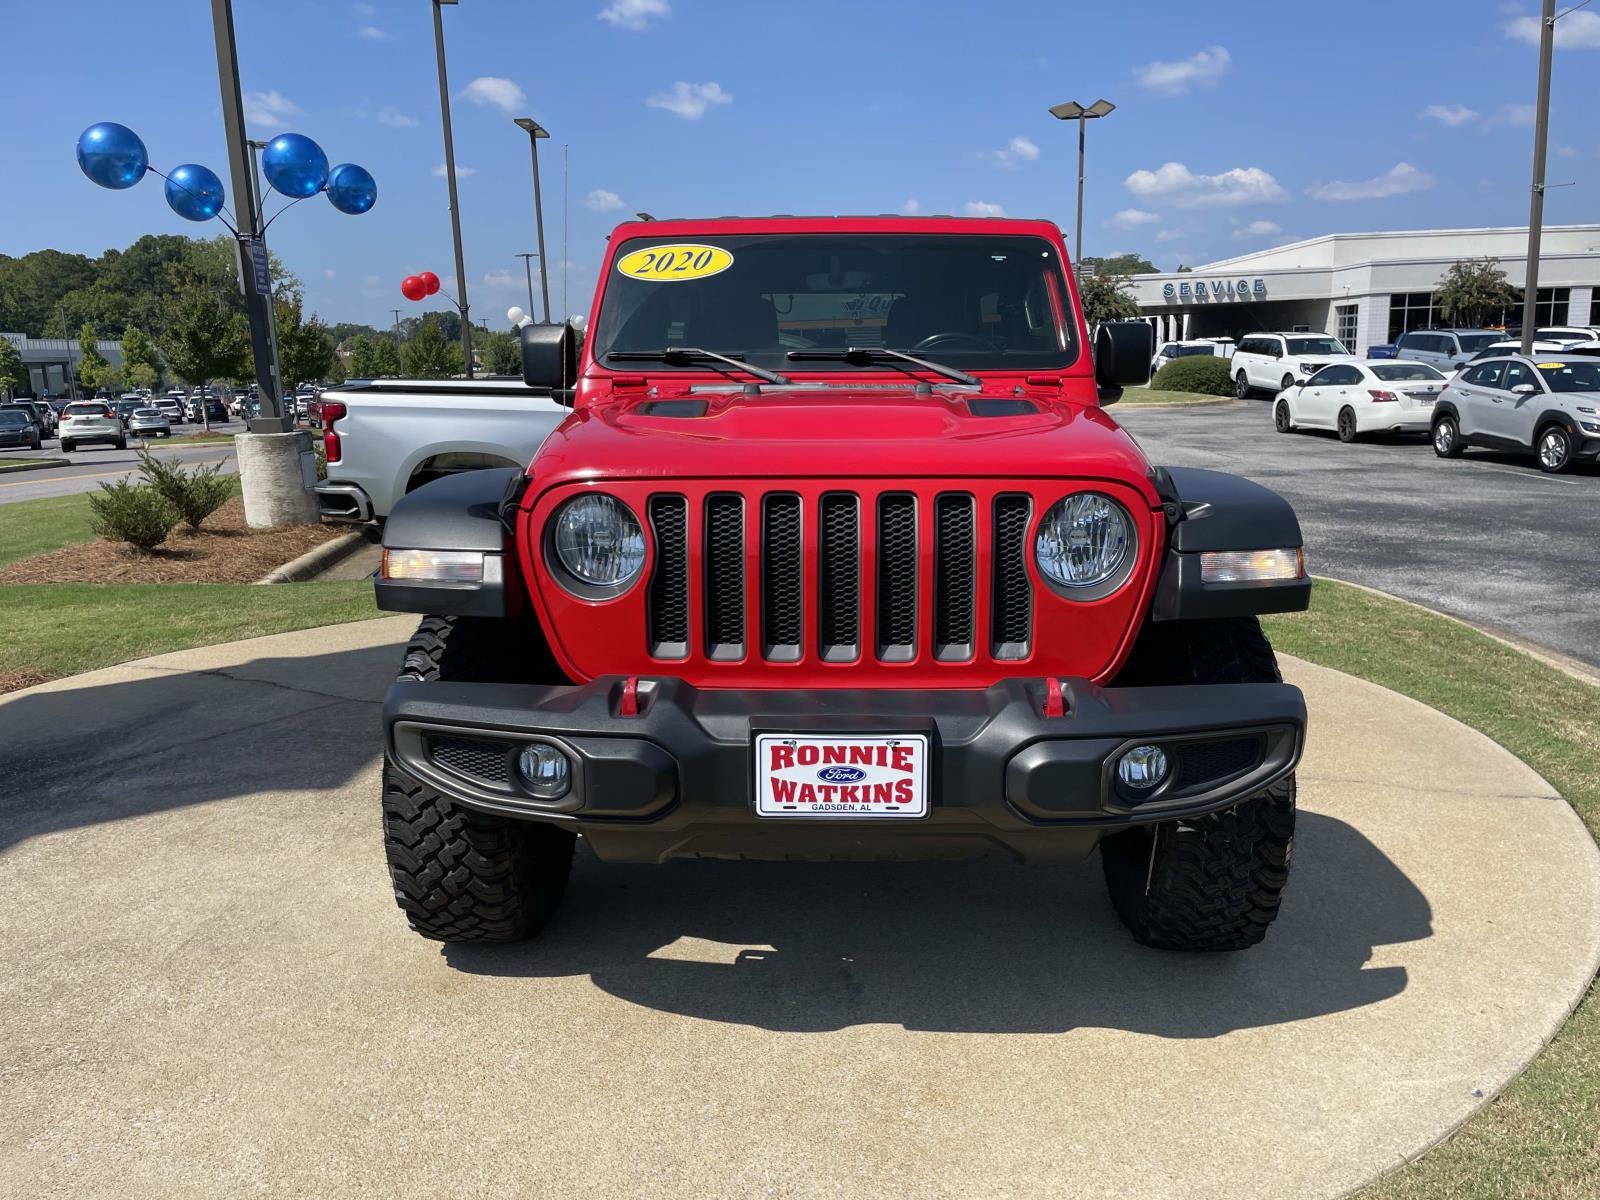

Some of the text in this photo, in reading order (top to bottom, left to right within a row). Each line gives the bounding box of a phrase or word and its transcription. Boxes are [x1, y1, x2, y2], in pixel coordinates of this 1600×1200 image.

[635, 250, 713, 273] 2020
[1163, 279, 1265, 297] SERVICE
[770, 745, 914, 773] RONNIE
[825, 768, 859, 780] Ford
[770, 777, 914, 804] WATKINS
[811, 803, 872, 812] GADSDEN, AL
